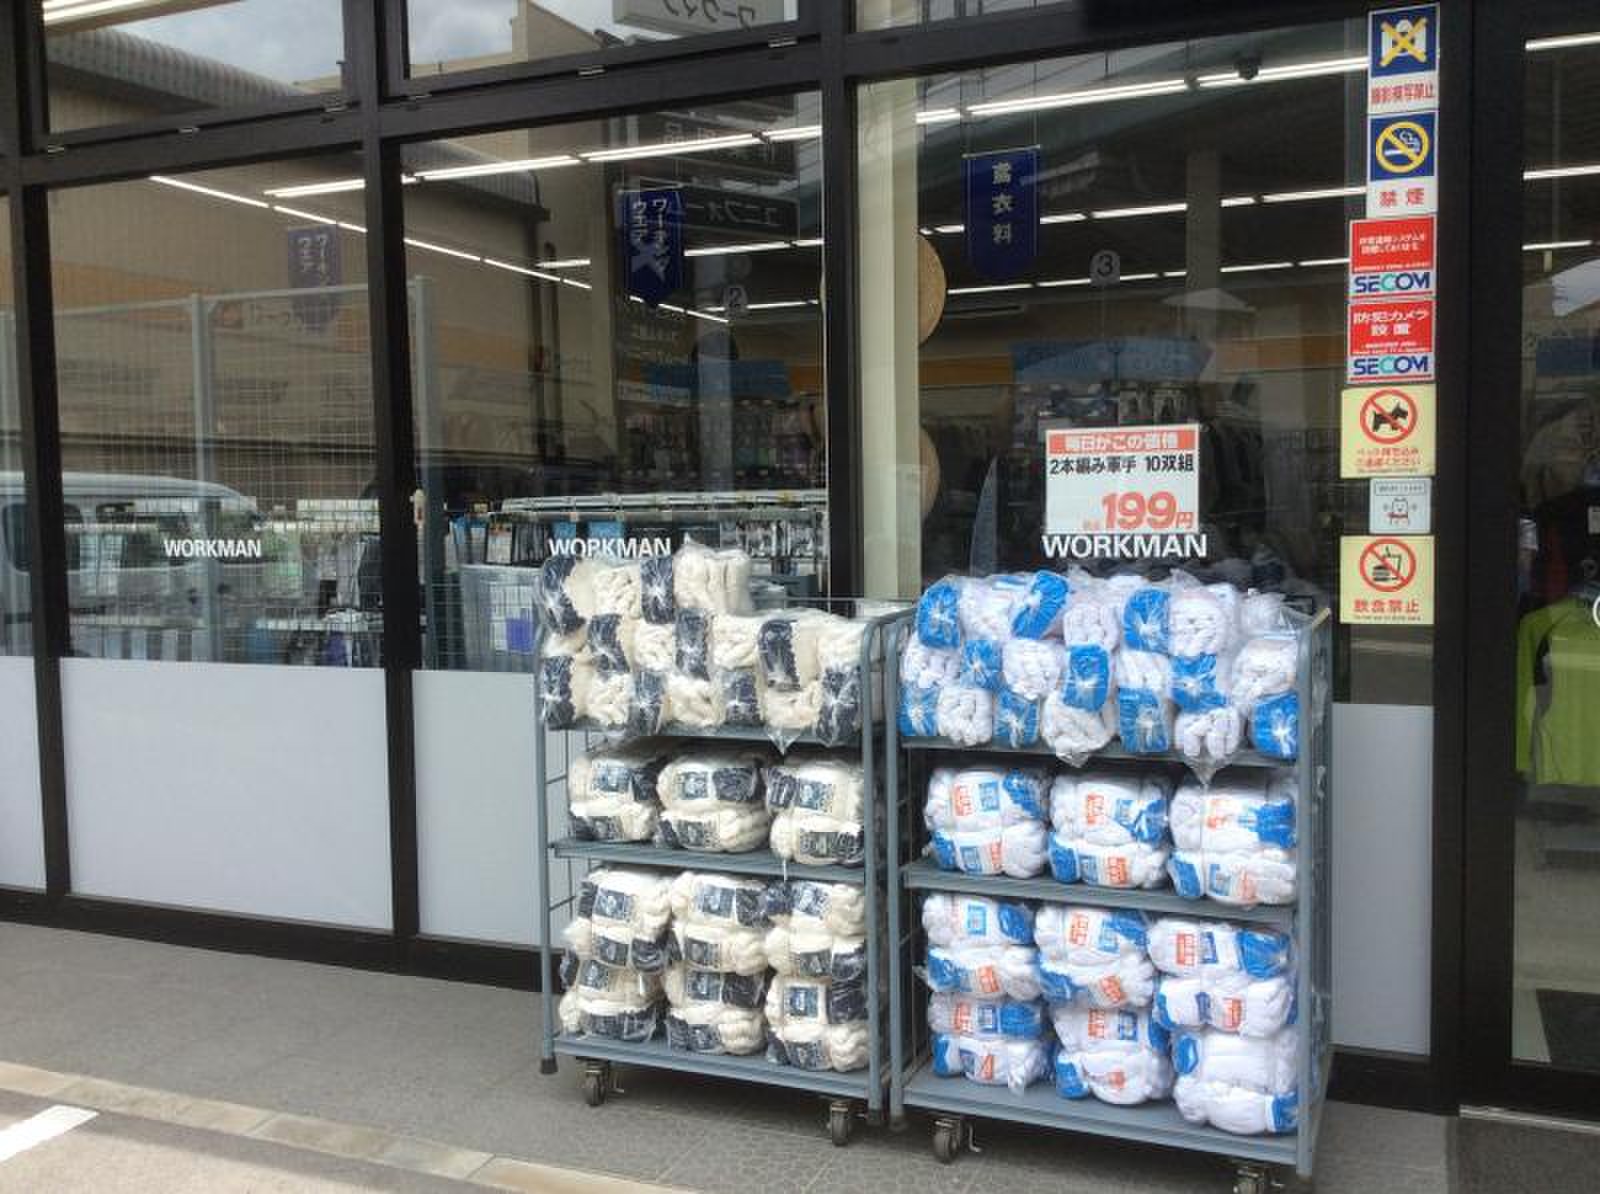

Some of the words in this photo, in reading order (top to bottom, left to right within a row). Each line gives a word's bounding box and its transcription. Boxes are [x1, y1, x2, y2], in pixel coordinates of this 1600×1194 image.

[1098, 254, 1114, 277] 3
[1354, 272, 1430, 293] SECOM
[1353, 356, 1428, 375] SECOM
[1144, 453, 1194, 472] 10双組
[163, 539, 262, 558] WORKMAN
[549, 536, 671, 557] WORKMAN
[1042, 533, 1207, 559] WORKMAN
